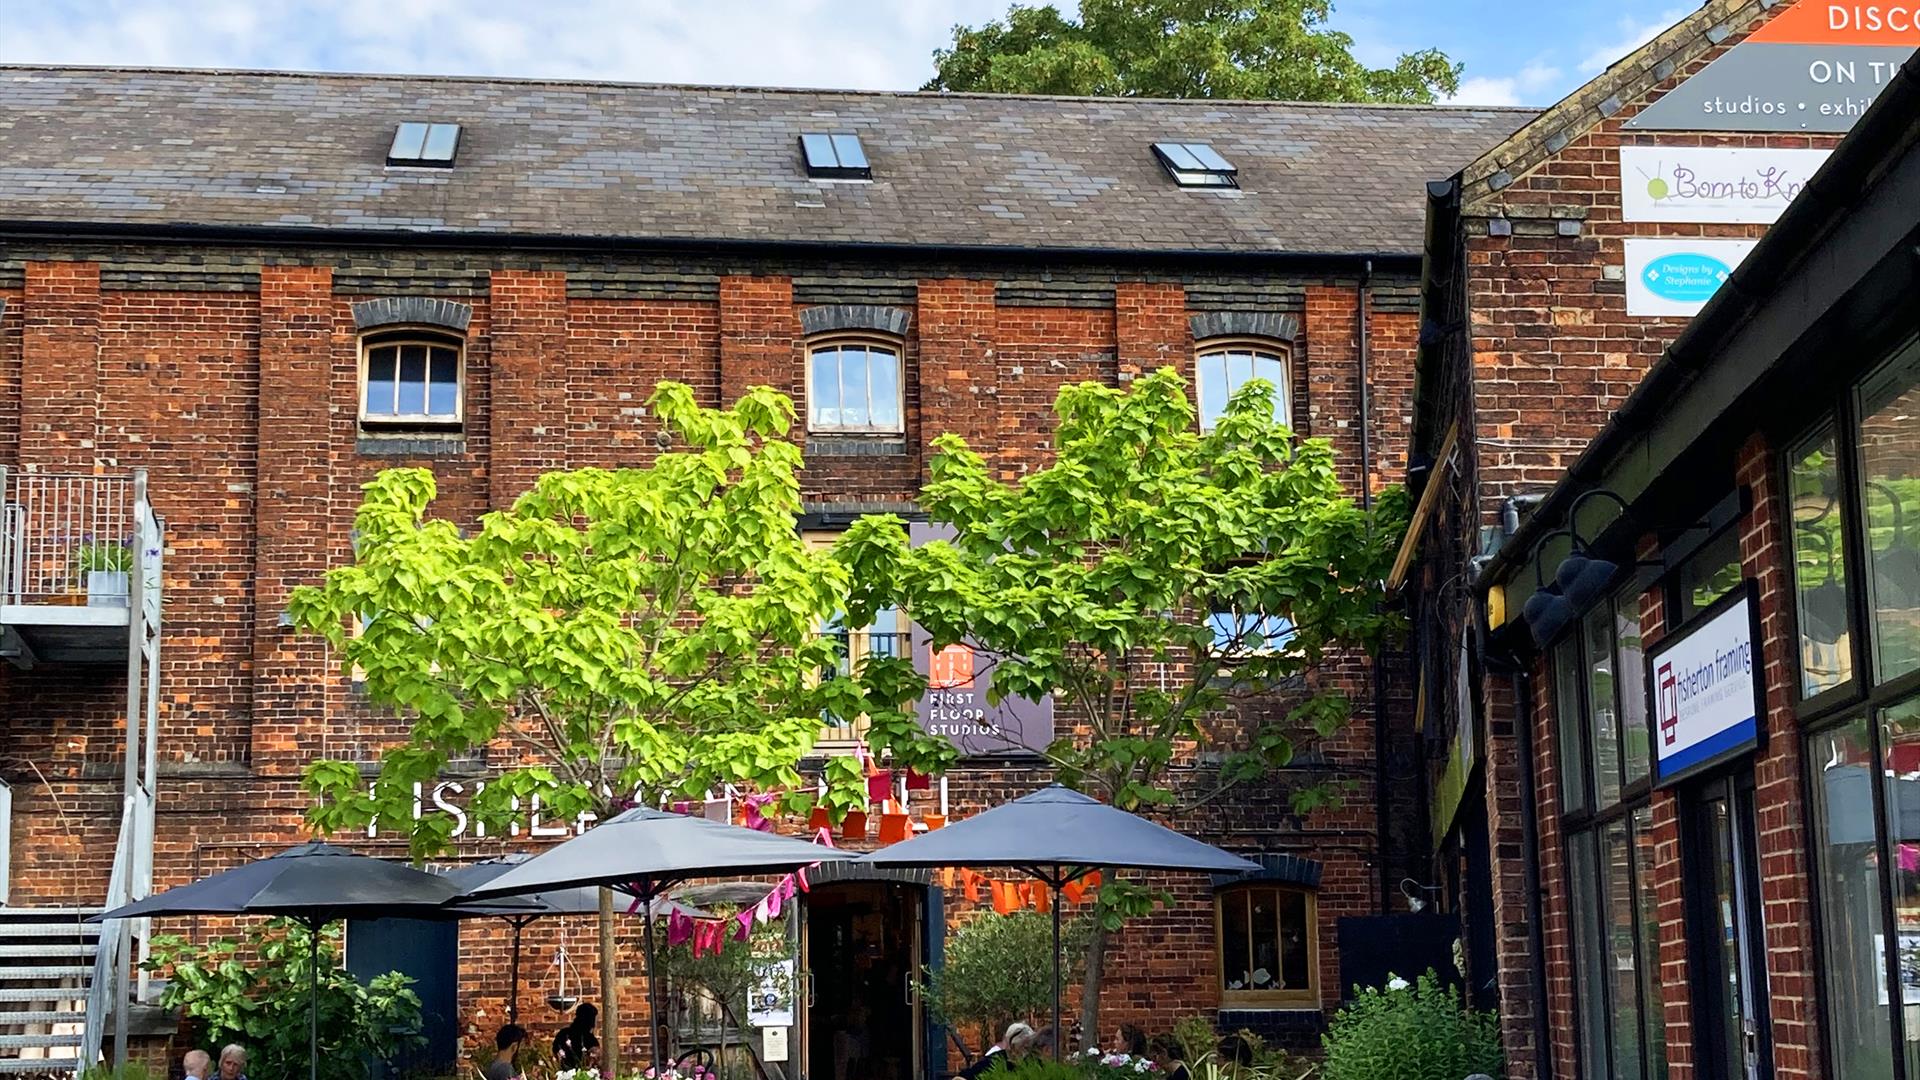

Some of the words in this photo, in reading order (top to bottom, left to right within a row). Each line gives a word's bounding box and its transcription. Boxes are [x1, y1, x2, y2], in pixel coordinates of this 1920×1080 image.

[1828, 5, 1920, 31] DISC
[1809, 60, 1855, 84] ON
[1703, 96, 1786, 115] studios
[1820, 97, 1871, 116] exhi
[1662, 264, 1698, 276] Designs
[1701, 264, 1714, 275] by
[1664, 275, 1712, 287] Stephanie
[1677, 660, 1714, 704] fisherton
[1715, 637, 1751, 675] framing
[929, 693, 974, 704] FIRST
[929, 709, 984, 721] FLOOR
[929, 724, 1000, 736] STUDIOS
